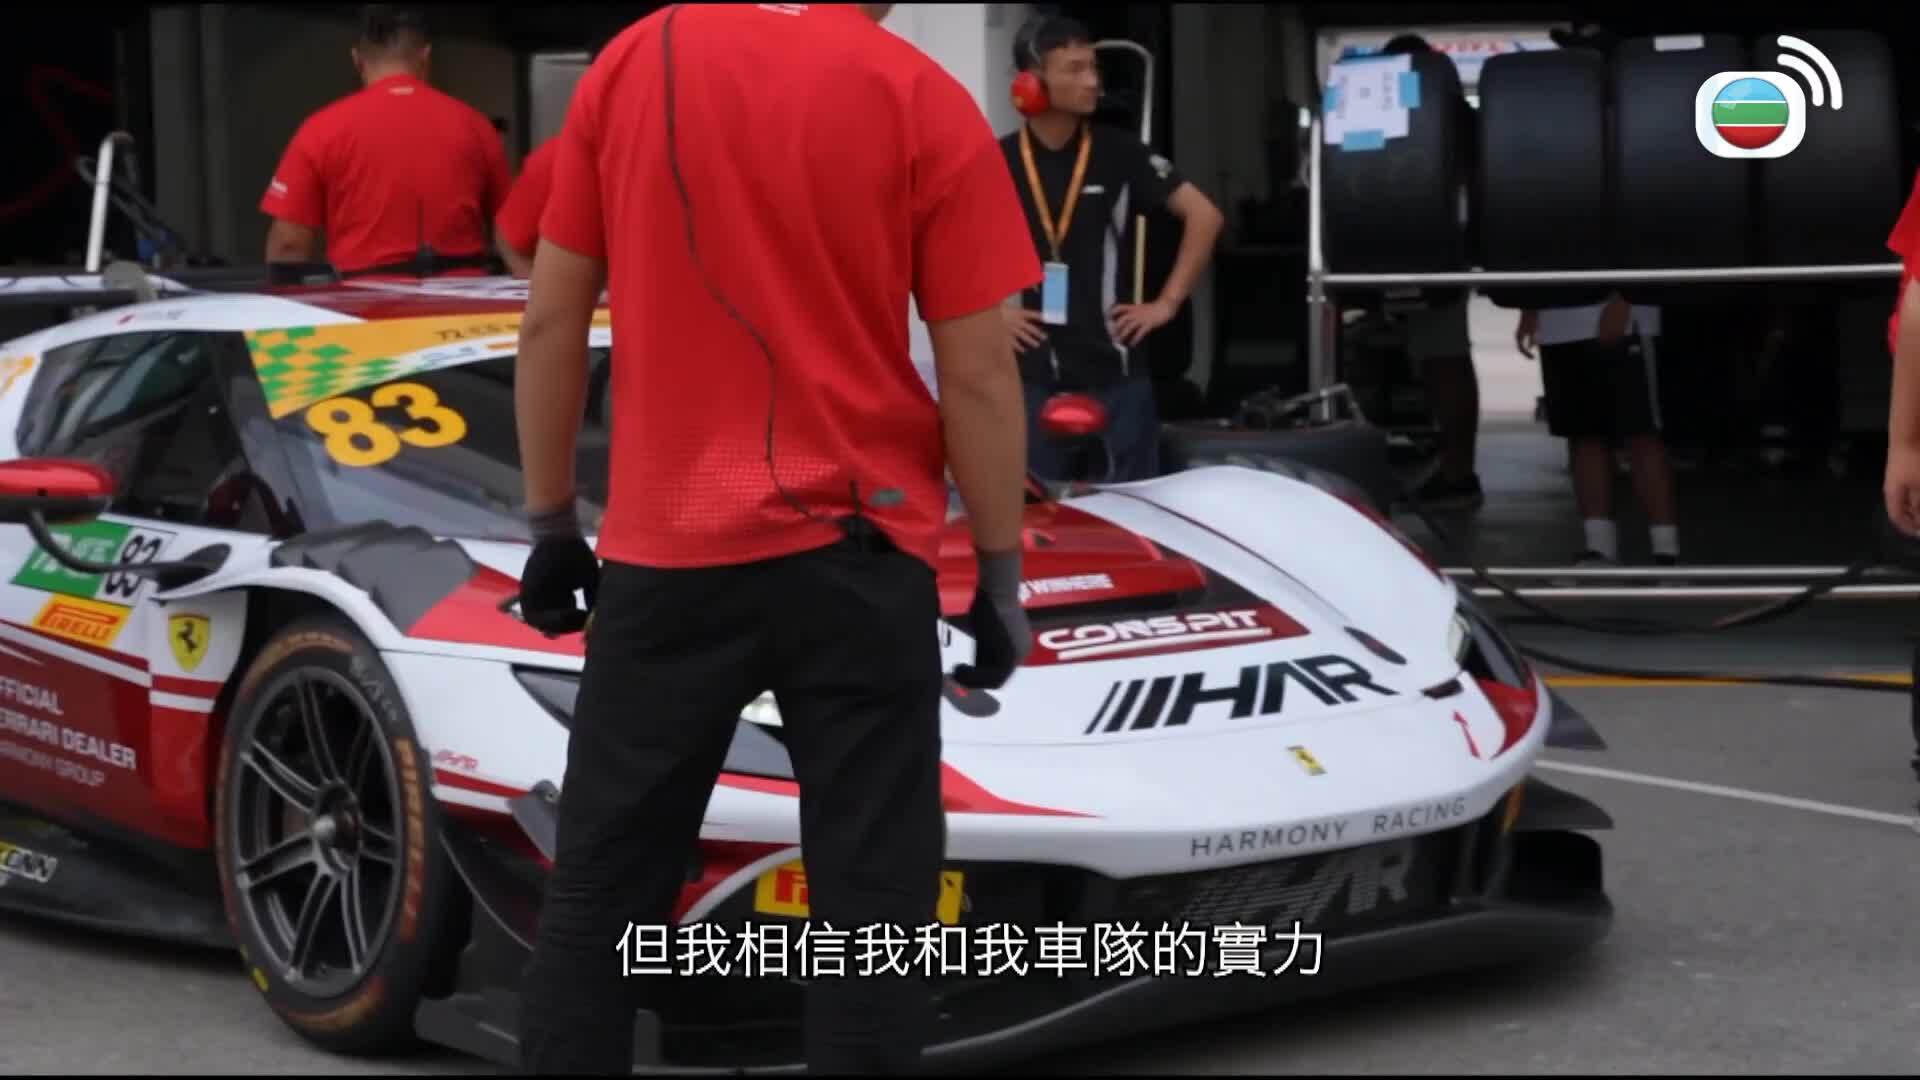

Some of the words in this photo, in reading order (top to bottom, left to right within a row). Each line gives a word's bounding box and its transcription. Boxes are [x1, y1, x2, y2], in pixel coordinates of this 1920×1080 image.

[305, 383, 467, 467] 83
[104, 534, 163, 598] 83
[39, 603, 120, 642] PIRELLI
[1037, 609, 1259, 651] CONSPIT
[62, 727, 137, 771] DEALER
[1190, 819, 1350, 858] HARMONY
[1372, 796, 1467, 835] RACING
